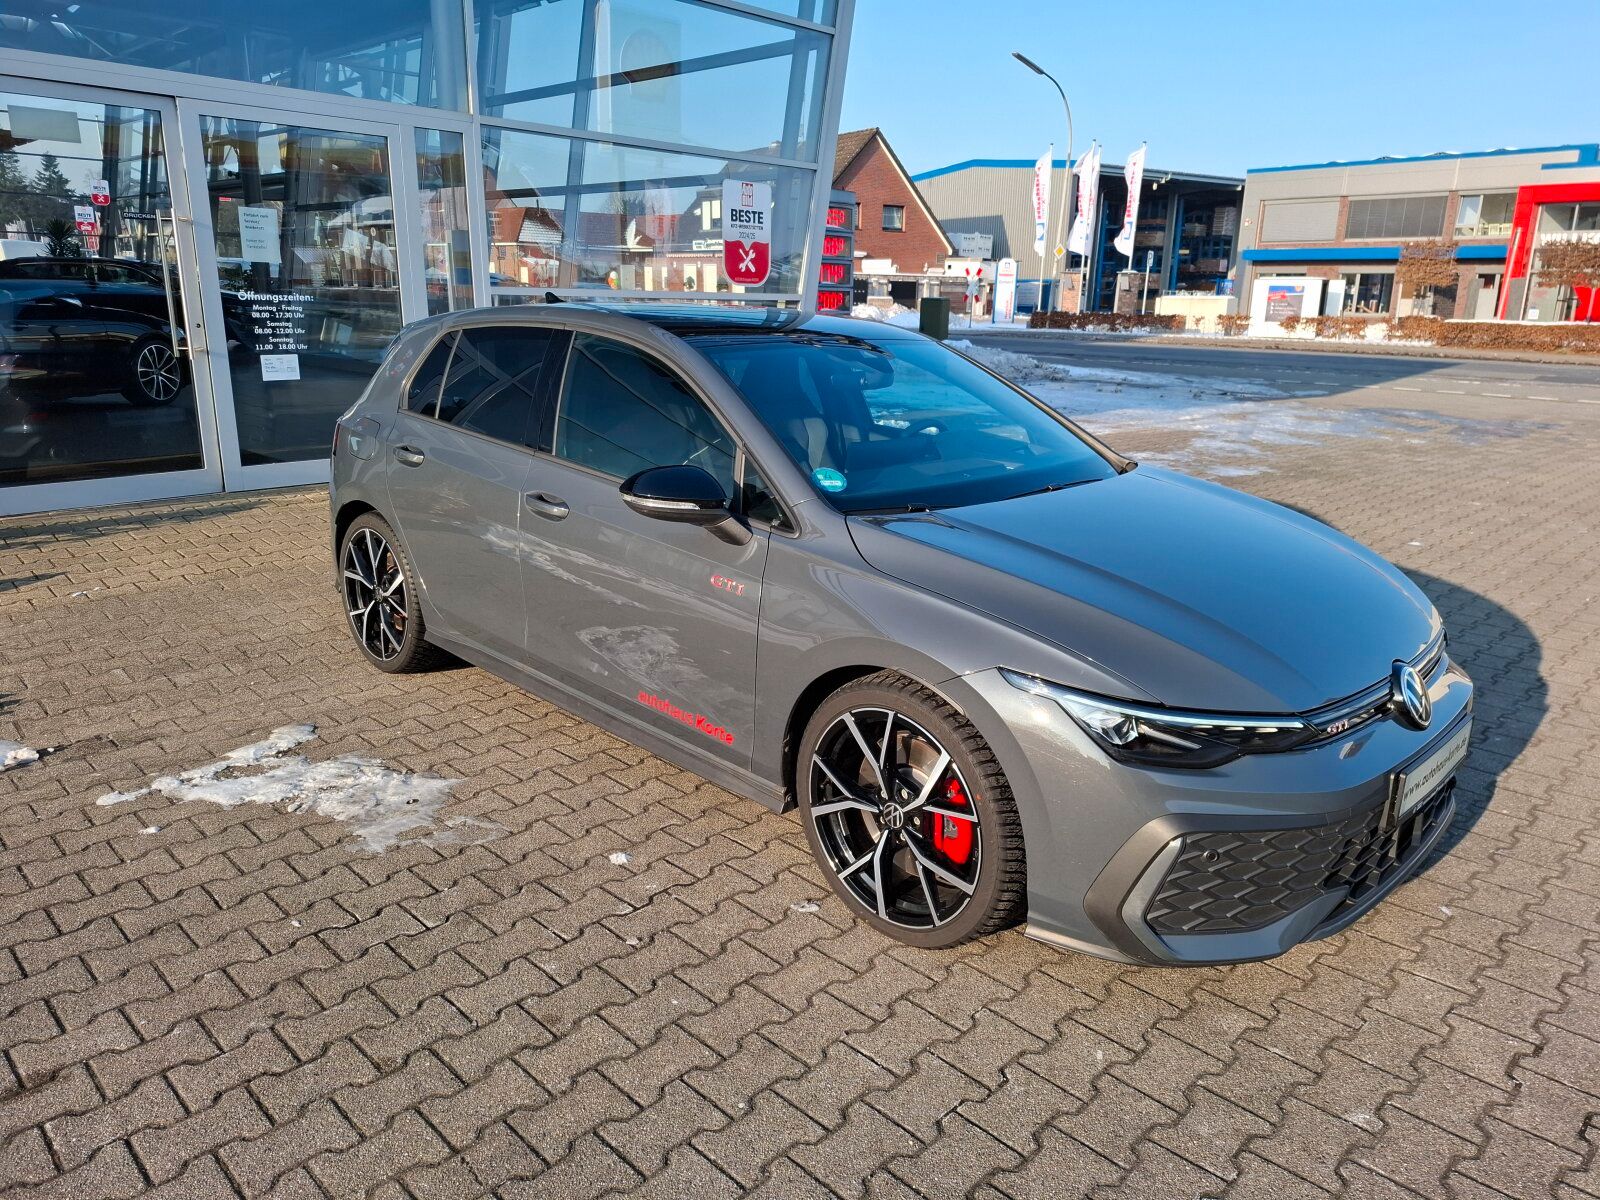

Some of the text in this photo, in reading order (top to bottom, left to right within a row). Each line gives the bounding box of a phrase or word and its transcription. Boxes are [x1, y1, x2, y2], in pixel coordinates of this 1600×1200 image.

[731, 208, 764, 225] BESTE
[238, 289, 314, 303] Öffnungszeiten:
[252, 304, 277, 312] Montag
[281, 304, 303, 312] Freitag
[266, 320, 293, 328] Samstag
[268, 336, 294, 344] Sonntag
[710, 574, 745, 597] GTI
[637, 690, 735, 746] autohaus Korte
[1327, 719, 1350, 736] GTI
